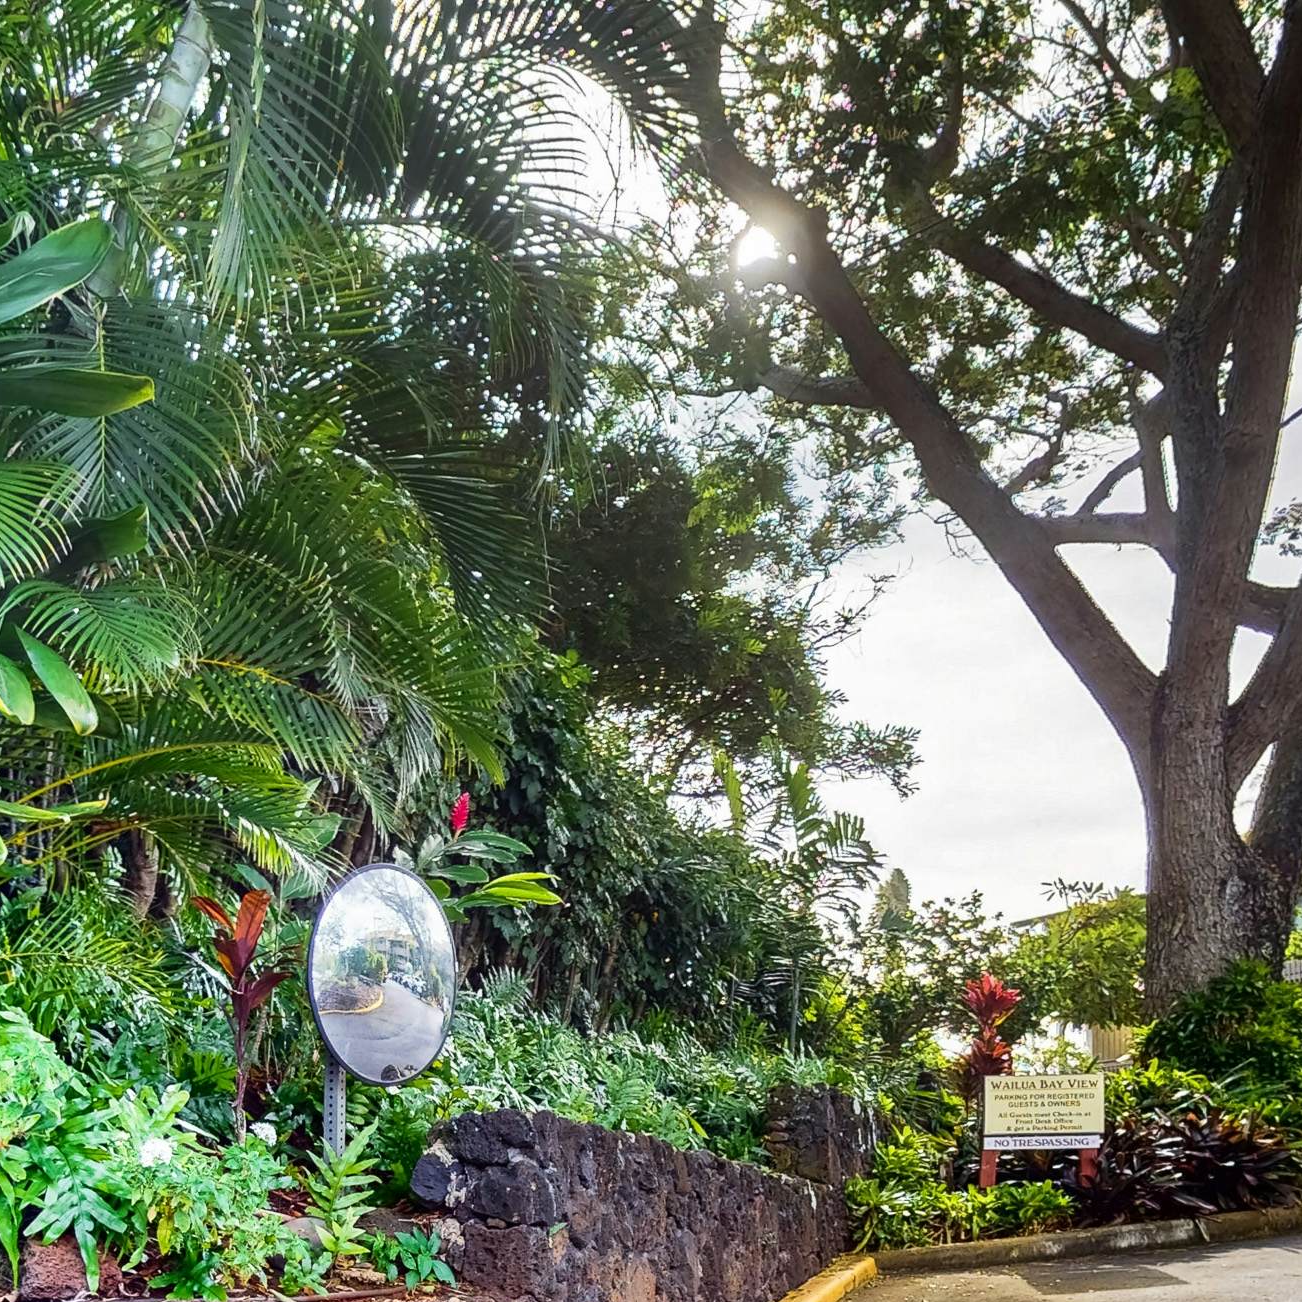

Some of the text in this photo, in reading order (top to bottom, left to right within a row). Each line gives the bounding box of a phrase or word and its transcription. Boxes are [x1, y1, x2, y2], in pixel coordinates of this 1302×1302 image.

[990, 1079, 1098, 1090] WAILUA BAY VIEW
[1032, 1124, 1058, 1132] Parking
[994, 1137, 1090, 1148] NO TRESPASSING
